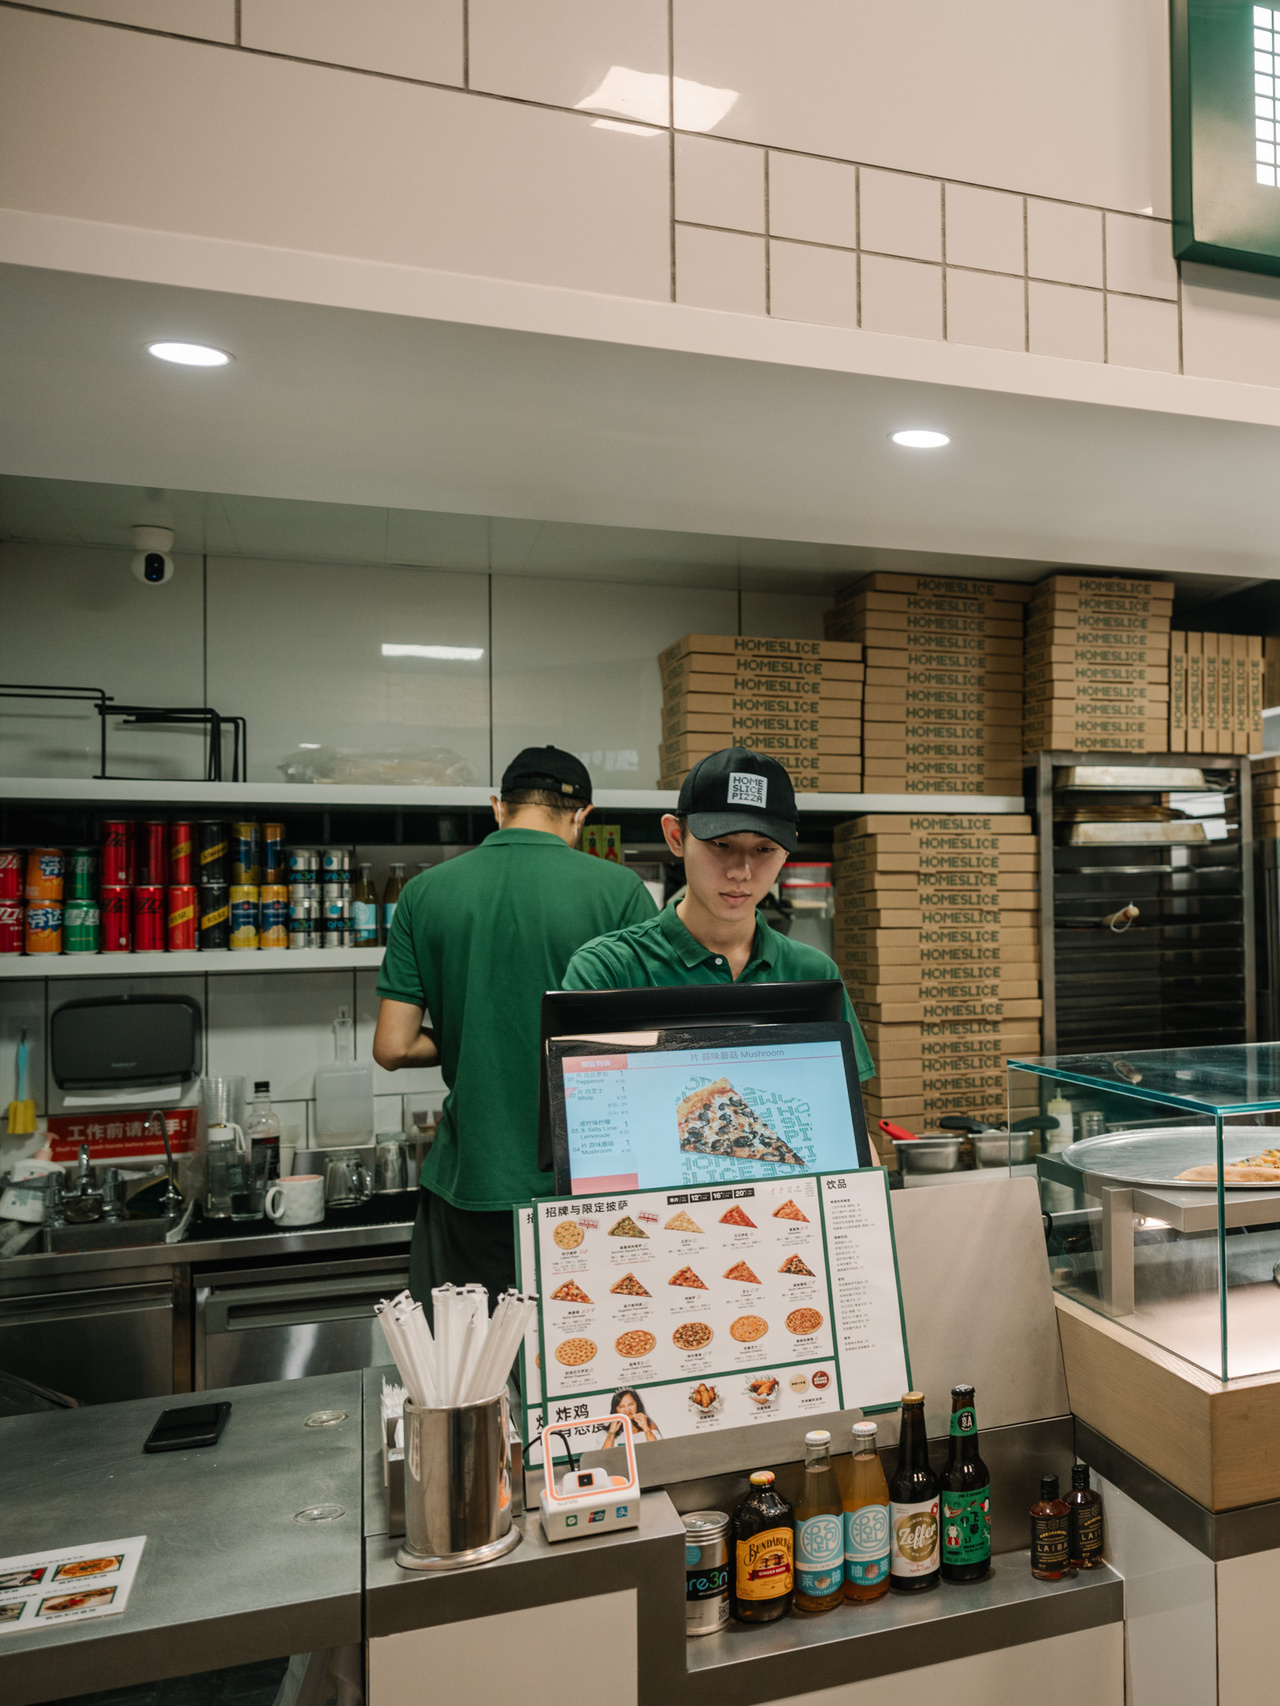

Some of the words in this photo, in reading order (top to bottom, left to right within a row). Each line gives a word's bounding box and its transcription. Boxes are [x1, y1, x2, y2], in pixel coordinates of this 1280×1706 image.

[1079, 580, 1151, 594] HOMESLICE
[1078, 598, 1150, 612] HOMESLICE
[1078, 615, 1148, 628] HOMESLICE
[908, 634, 986, 650] HOMESLICE
[1076, 632, 1148, 645] HOMESLICE
[734, 638, 820, 655] HOMESLICE
[908, 653, 986, 668] HOMESLICE
[1075, 650, 1146, 663] HOMESLICE
[736, 658, 822, 675] HOMESLICE
[1076, 667, 1146, 680] HOMESLICE
[734, 678, 820, 694] HOMESLICE
[908, 672, 986, 686] HOMESLICE
[906, 690, 985, 704] HOMESLICE
[1076, 685, 1146, 698] HOMESLICE
[1174, 655, 1184, 729] HOMESLICE
[1191, 656, 1200, 729] HOMESLICE
[1208, 656, 1217, 729] HOMESLICE
[1222, 656, 1230, 730] HOMESLICE
[1237, 658, 1246, 731] HOMESLICE
[1252, 659, 1260, 732] HOMESLICE
[733, 698, 819, 714] HOMESLICE
[1075, 703, 1145, 716] HOMESLICE
[906, 707, 985, 722] HOMESLICE
[732, 717, 818, 732] HOMESLICE
[1075, 720, 1146, 732] HOMESLICE
[906, 725, 984, 740] HOMESLICE
[1075, 736, 1146, 749] HOMESLICE
[906, 743, 984, 758] HOMESLICE
[906, 762, 986, 776] HOMESLICE
[734, 776, 764, 788] HOME
[906, 780, 984, 793] HOMESLICE
[732, 785, 763, 796] SLICE
[732, 793, 763, 804] PIZZA
[910, 817, 991, 830] HOMESLICE
[920, 837, 999, 850] HOMESLICE
[920, 856, 999, 868] HOMESLICE
[918, 874, 998, 886] HOMESLICE
[920, 894, 1000, 906] HOMESLICE
[922, 912, 1001, 924] HOMESLICE
[919, 930, 999, 943] HOMESLICE
[920, 948, 1000, 960] HOMESLICE
[922, 966, 1001, 980] HOMESLICE
[918, 985, 999, 998] HOMESLICE
[924, 1003, 1004, 1018] HOMESLICE
[920, 1022, 1002, 1036] HOMESLICE
[740, 1050, 784, 1058] Mushroom
[922, 1040, 1002, 1054] HOMESLICE
[922, 1056, 1002, 1072] HOMESLICE
[923, 1075, 1003, 1090] HOMESLICE
[924, 1094, 1004, 1110] HOMESLICE
[826, 1178, 847, 1190] 饮品
[545, 1200, 628, 1218] 招牌与限定披萨
[556, 1404, 590, 1422] 炸鸡
[898, 1523, 938, 1550] Zeffer
[1038, 1542, 1068, 1552] LAIBA
[758, 1569, 776, 1578] GINGER
[851, 1564, 862, 1578] 柚
[686, 1570, 728, 1593] re3n
